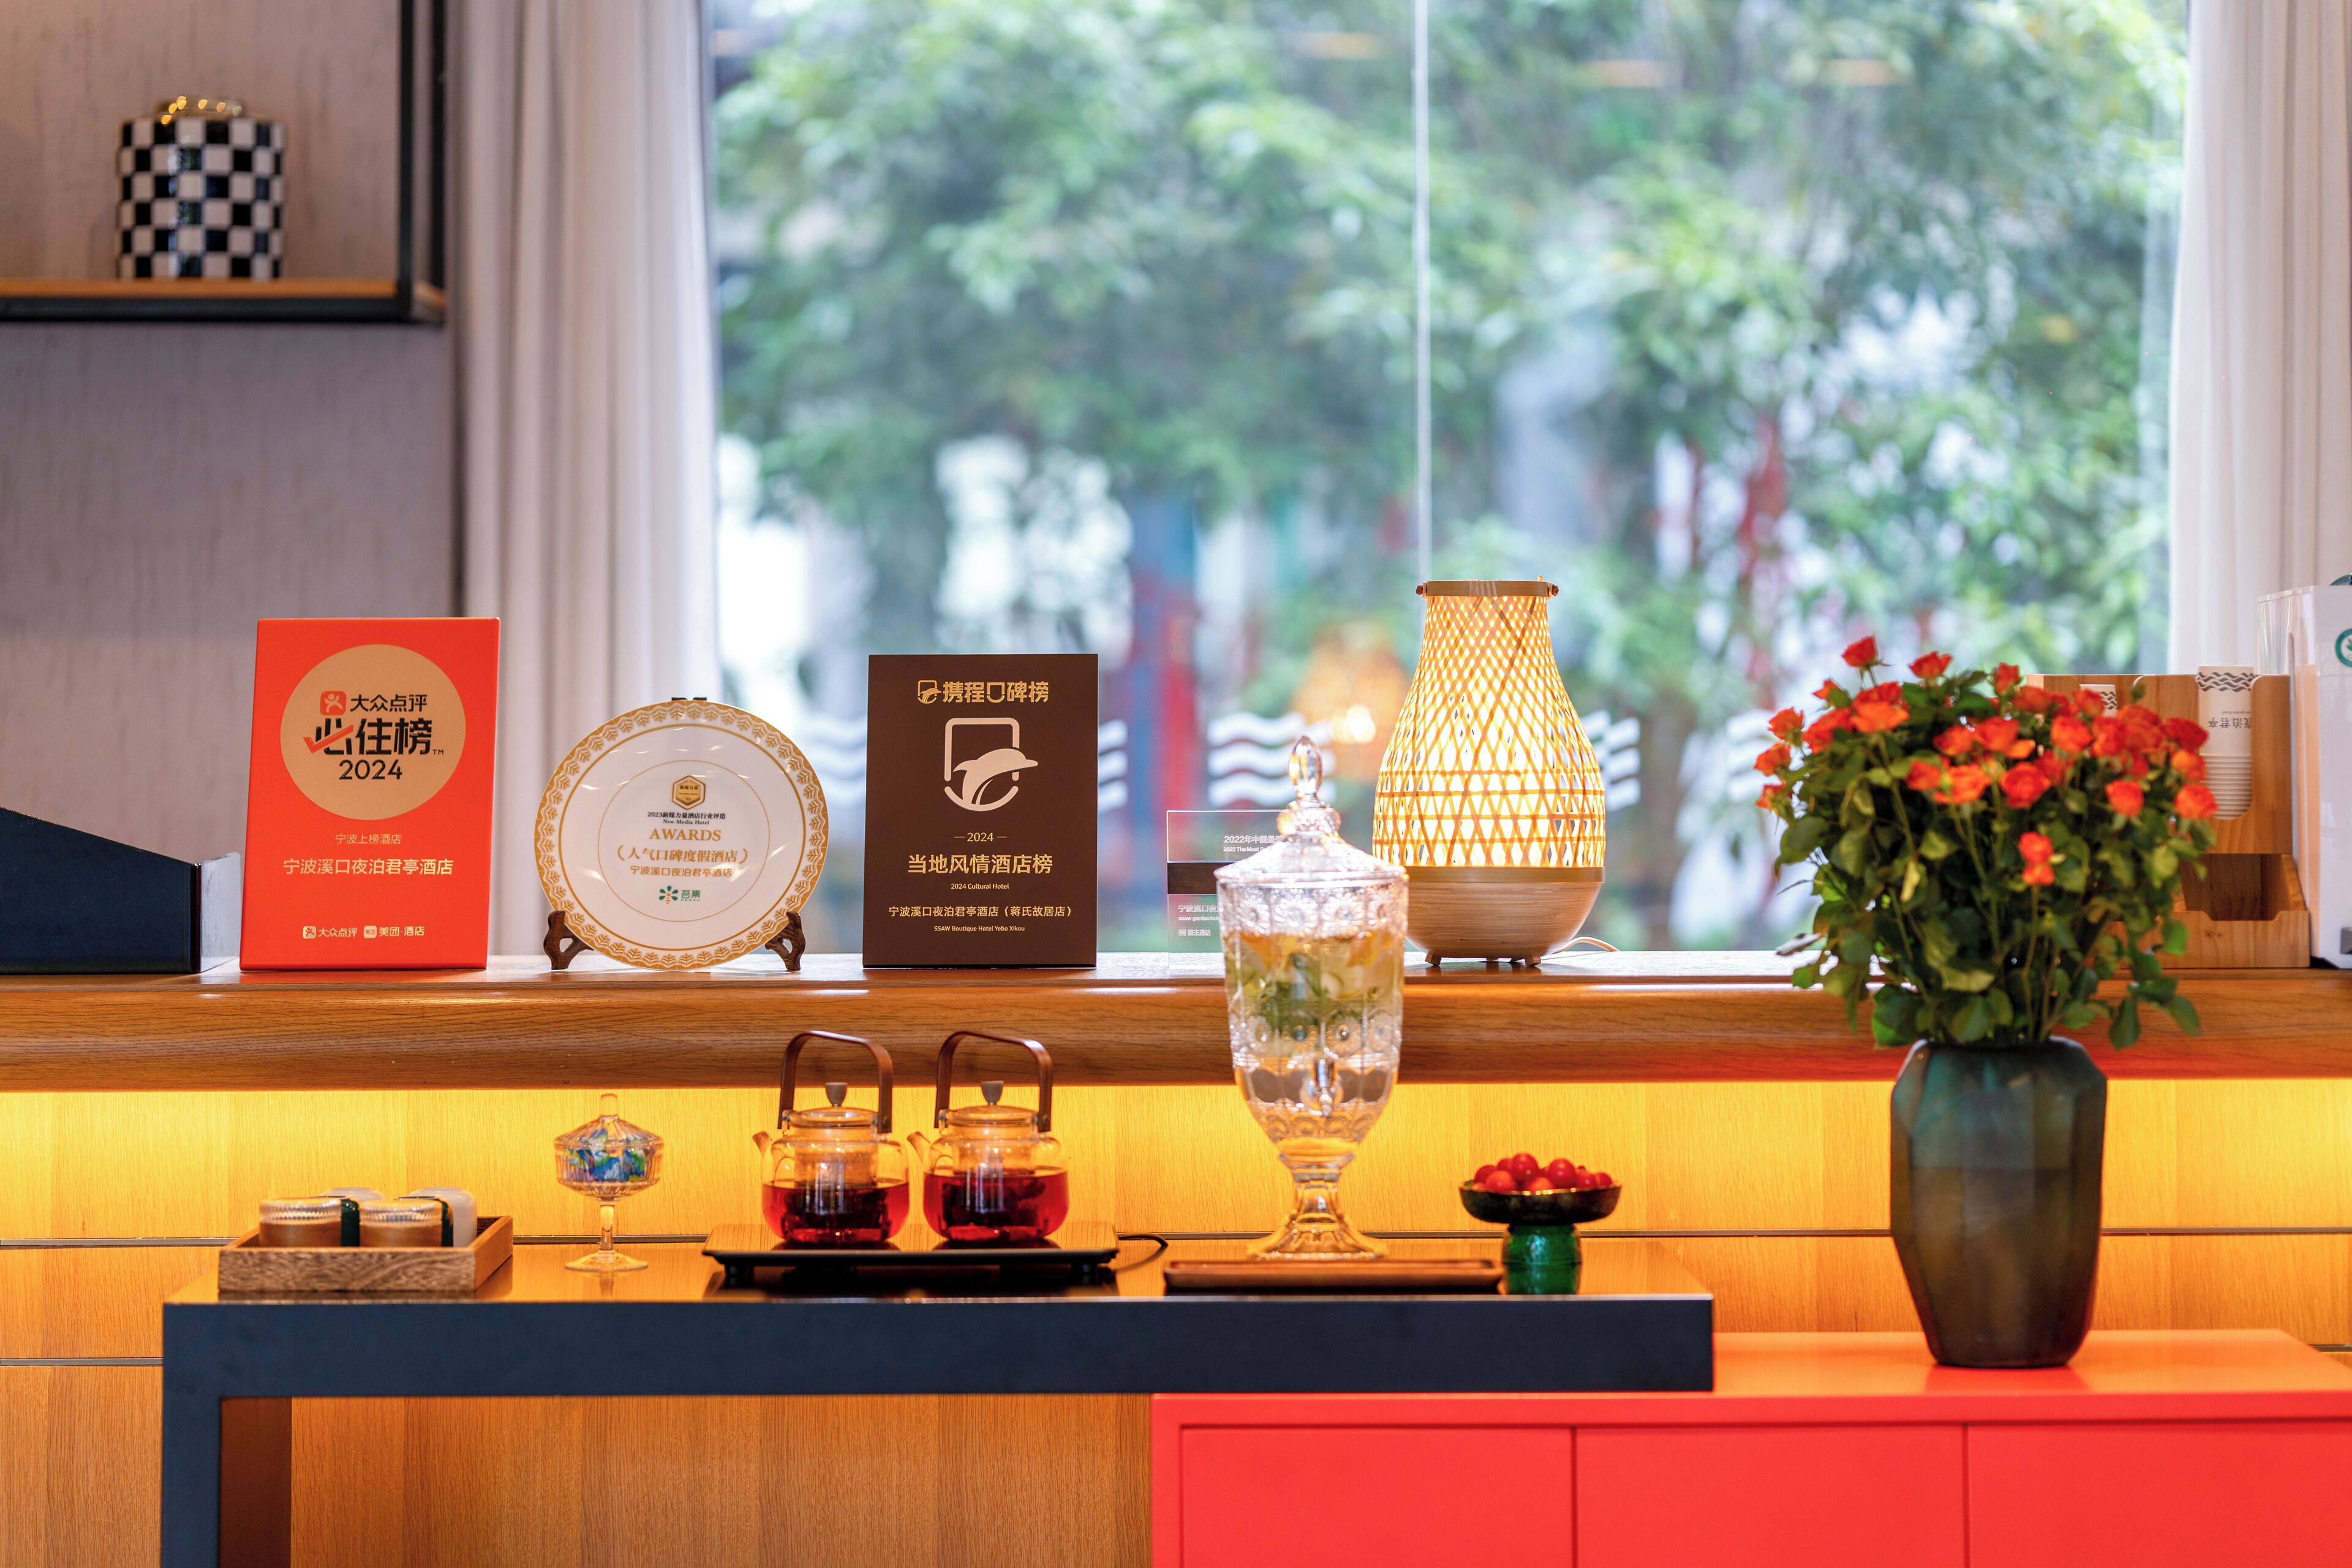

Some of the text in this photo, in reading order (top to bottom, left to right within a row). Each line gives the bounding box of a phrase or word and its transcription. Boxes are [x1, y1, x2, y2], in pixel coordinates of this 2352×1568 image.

[942, 680, 1049, 703] 携程口碑榜
[350, 694, 428, 712] 大众点评
[338, 759, 402, 780] 2024
[335, 833, 402, 845] 宁波上榜酒店
[649, 828, 722, 842] AWARDS
[967, 832, 994, 842] 2024
[283, 858, 454, 875] 宁波溪口夜泊君亭酒店
[630, 865, 733, 877] 宁波溪口夜泊君亭酒店
[908, 854, 1053, 874] 当地风情酒店榜
[318, 927, 358, 938] 大众点评
